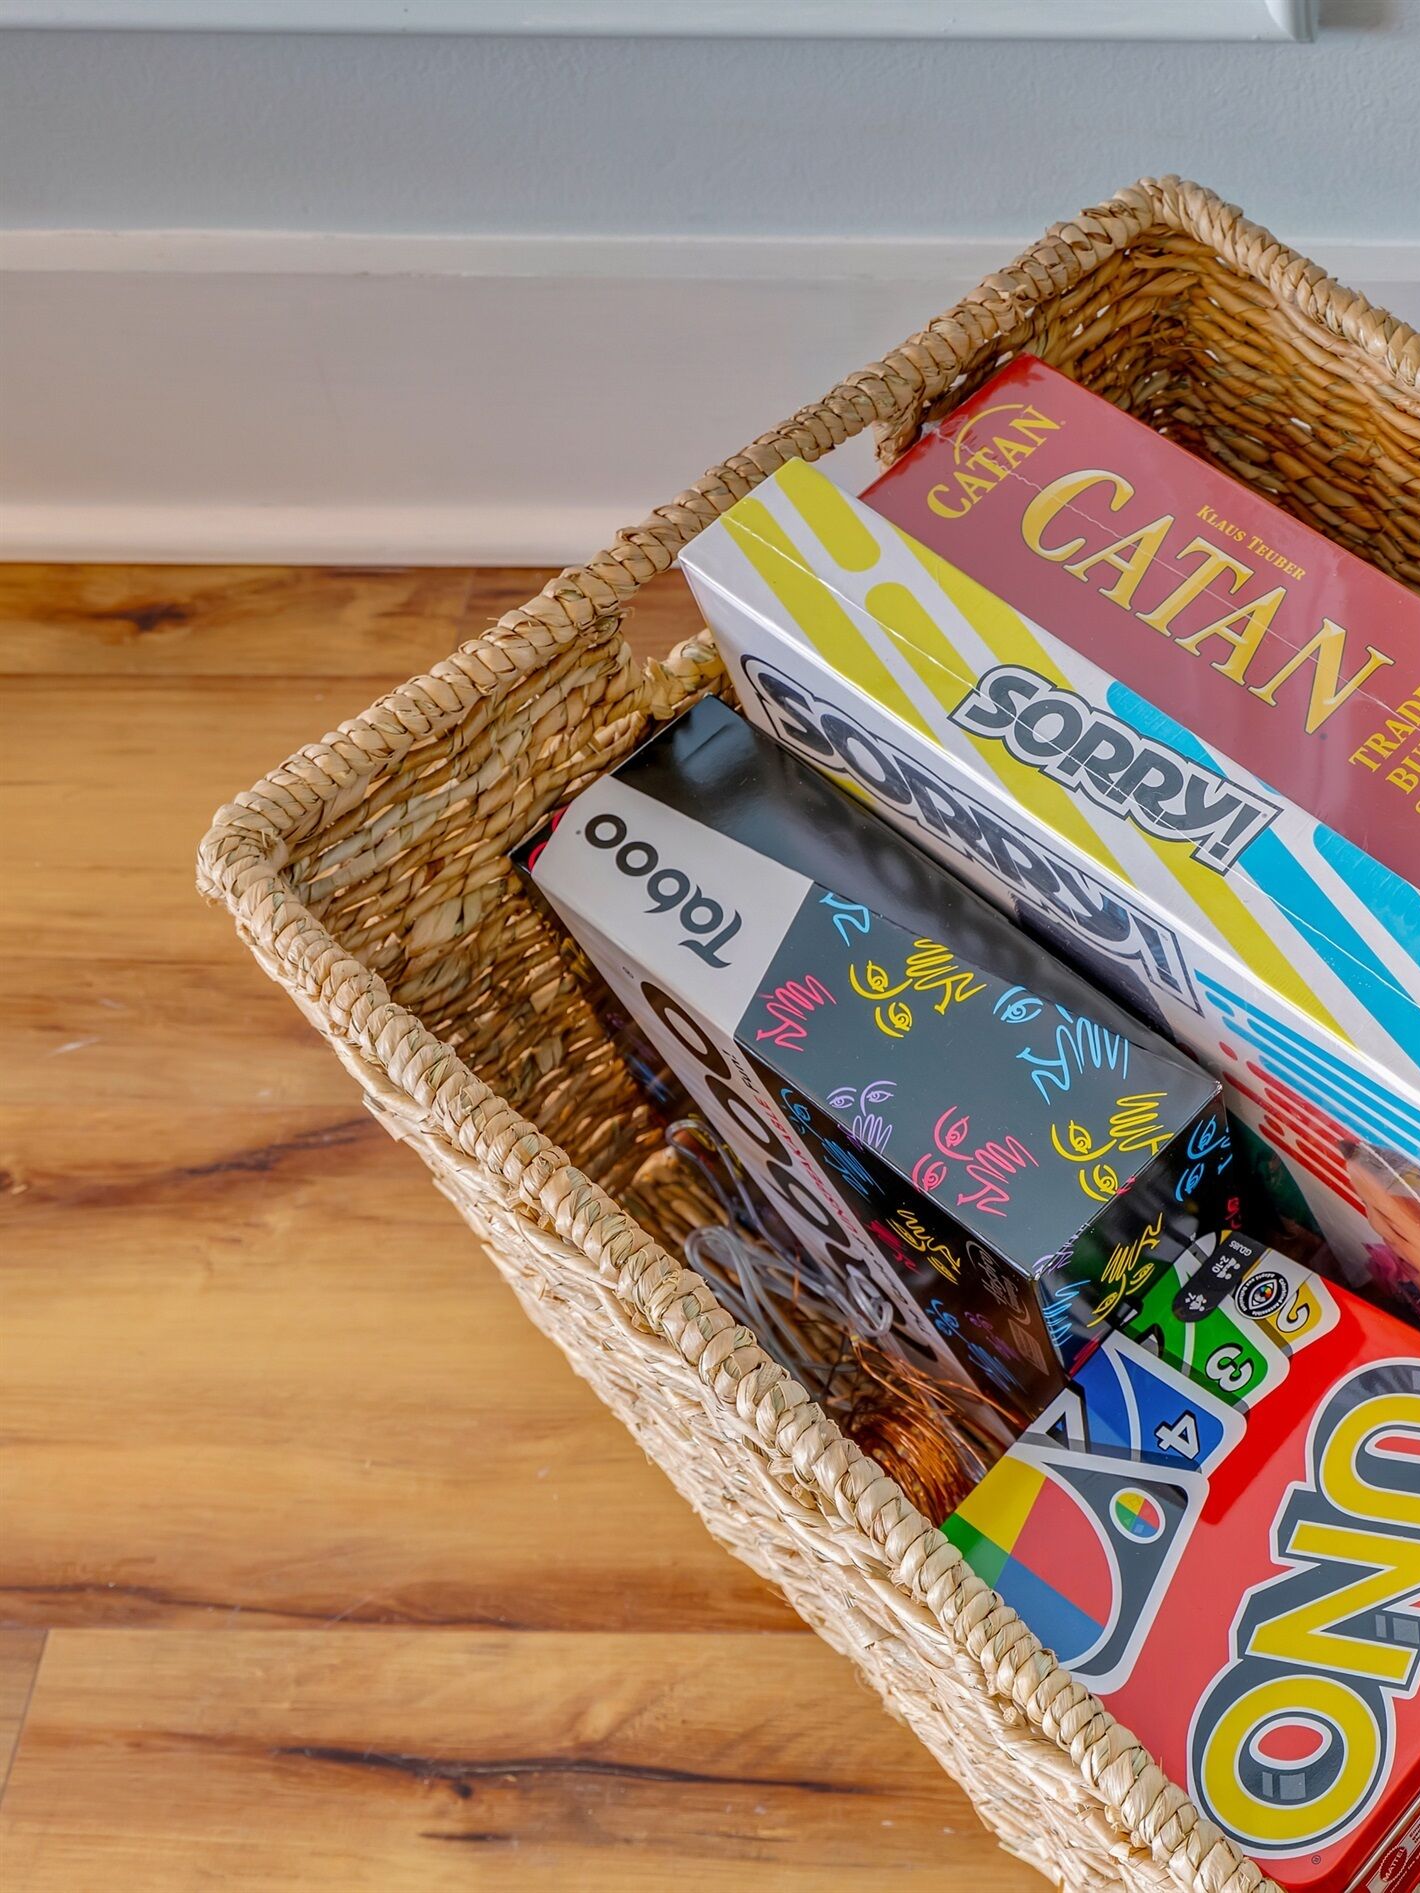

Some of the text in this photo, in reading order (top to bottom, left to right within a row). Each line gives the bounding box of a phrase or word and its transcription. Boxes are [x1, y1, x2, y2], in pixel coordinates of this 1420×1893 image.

[926, 404, 1061, 519] CATAN
[1196, 504, 1306, 582] KLAUS TEUBER
[1020, 468, 1397, 736] CATAN
[955, 666, 1276, 870] SORRY!
[584, 813, 745, 969] Taboo
[747, 661, 1197, 1011] SORRY!
[1206, 1343, 1254, 1392] 3
[1155, 1410, 1200, 1460] 4
[1382, 1848, 1405, 1881] MATTEL
